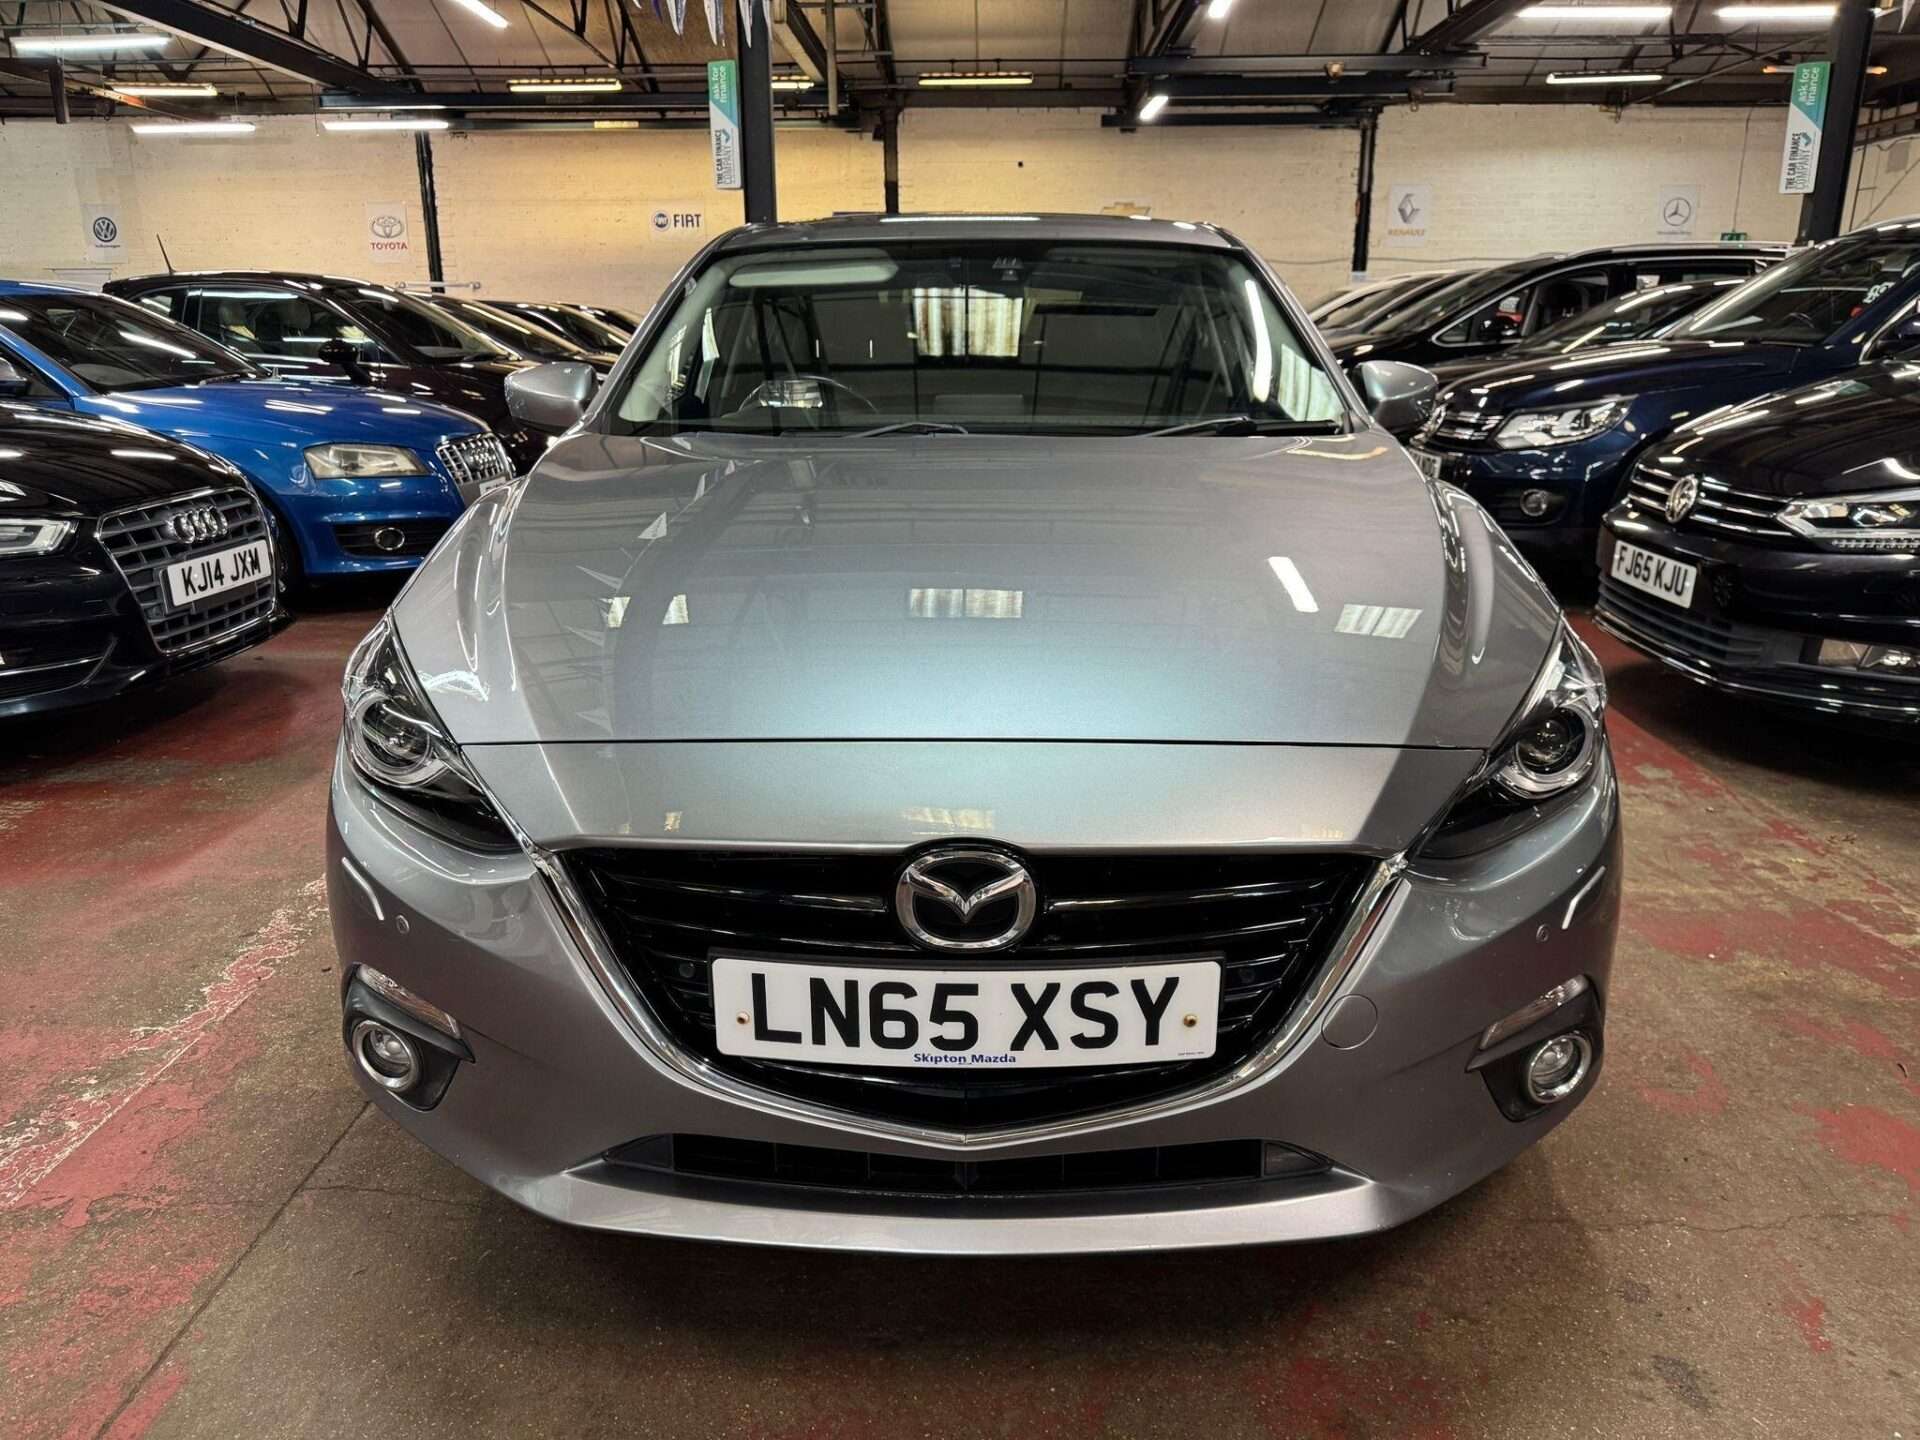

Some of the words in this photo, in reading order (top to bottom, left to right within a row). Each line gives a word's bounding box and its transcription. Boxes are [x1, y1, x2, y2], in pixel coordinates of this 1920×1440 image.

[720, 65, 728, 103] finance
[1800, 68, 1810, 82] for
[712, 83, 720, 100] ask
[1798, 84, 1809, 102] ask
[1806, 67, 1820, 106] finance
[1789, 132, 1801, 161] FINANCE
[1787, 163, 1797, 176] CAR
[1795, 148, 1810, 190] COMPANY
[1785, 177, 1795, 190] THE
[673, 213, 702, 228] FIAT
[370, 242, 408, 250] TOYOTA
[181, 558, 225, 596] KJ14
[230, 547, 262, 582] JXM
[1617, 545, 1654, 583] FJ65
[1653, 559, 1688, 597] KJU
[751, 972, 981, 1052] LN65
[1009, 976, 1181, 1052] XSY
[913, 1053, 966, 1065] Skipton
[971, 1053, 1016, 1063] Mazda
